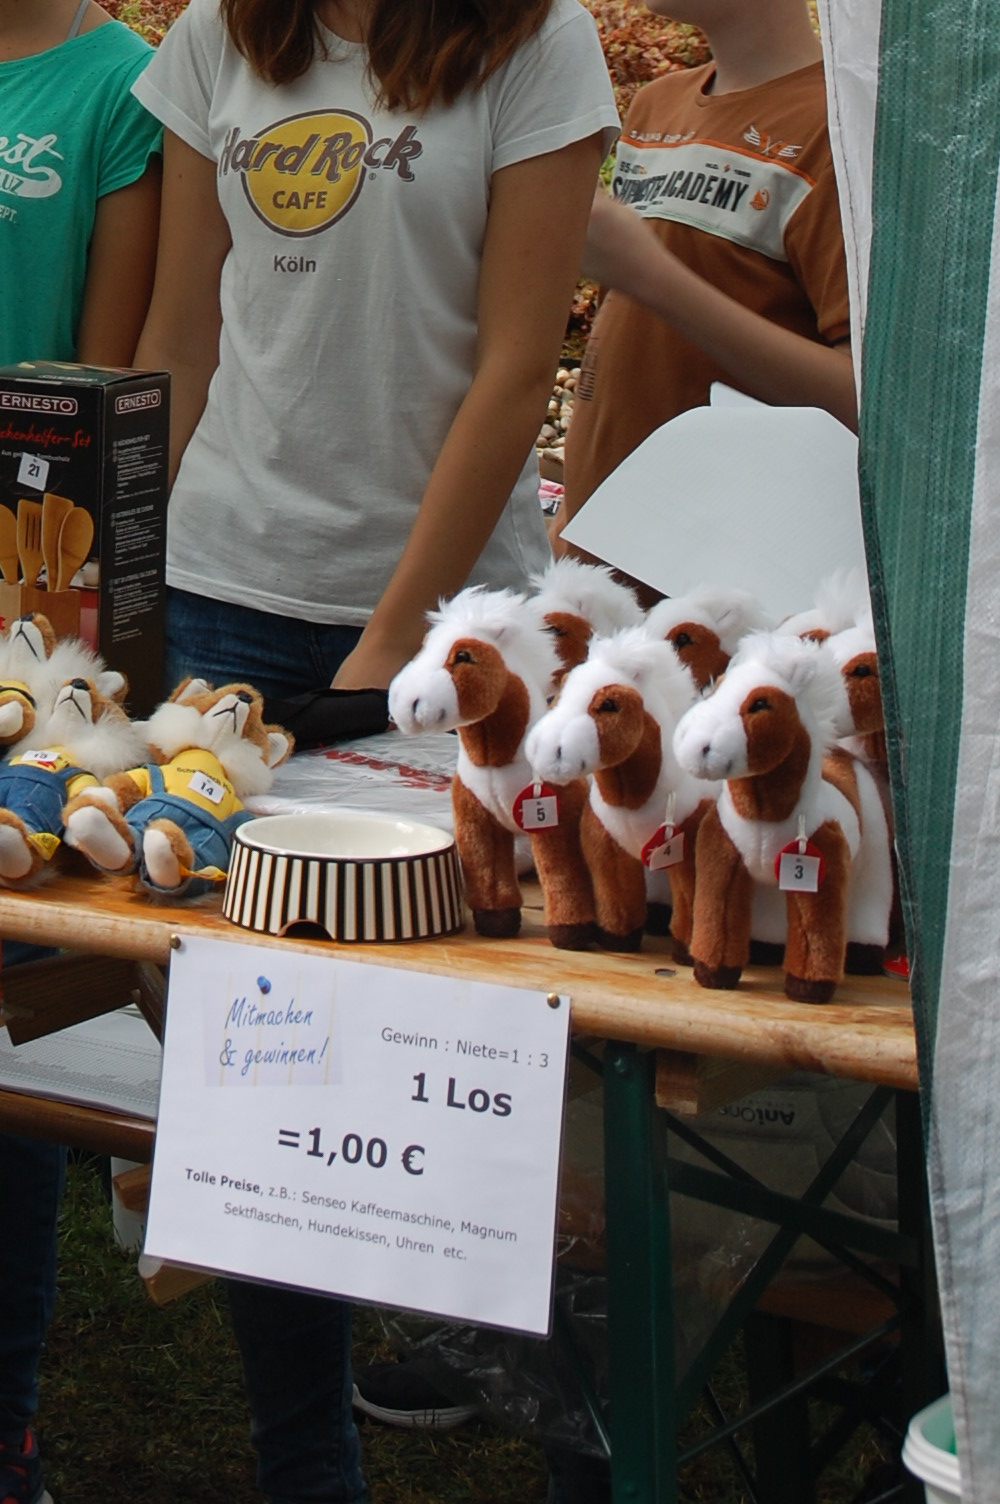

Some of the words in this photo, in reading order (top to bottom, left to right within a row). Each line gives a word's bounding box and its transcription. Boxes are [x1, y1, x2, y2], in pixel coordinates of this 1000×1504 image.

[219, 127, 322, 177] Hard
[311, 125, 423, 182] Rock
[272, 190, 328, 210] CAFE
[659, 170, 750, 212] ACADEMY
[273, 255, 317, 273] Köln
[1, 395, 74, 413] ERNESTO
[118, 392, 159, 411] ERNESTO
[27, 463, 40, 478] 21
[201, 782, 214, 796] 14
[536, 807, 546, 822] 5
[663, 845, 671, 857] 4
[795, 865, 804, 880] 3
[225, 997, 313, 1030] Mitmachen
[219, 1039, 236, 1067] &
[241, 1037, 329, 1076] gewinnen!
[381, 1027, 438, 1051] Gewinn
[539, 1052, 549, 1068] 3
[411, 1072, 429, 1103] 1
[447, 1077, 513, 1117] Los
[278, 1127, 388, 1169] =1,00
[401, 1145, 426, 1176] €
[185, 1168, 216, 1185] Tolle
[220, 1175, 264, 1196] Preise,
[268, 1187, 297, 1201] z.B.:
[301, 1191, 347, 1211] Senseo
[351, 1200, 455, 1234] Kaffeemaschine,
[460, 1221, 518, 1242] Magnum
[224, 1202, 302, 1232] Sektflaschen,
[307, 1219, 390, 1248] Hundekissen,
[396, 1235, 434, 1254] Uhren
[443, 1246, 467, 1261] etc.
